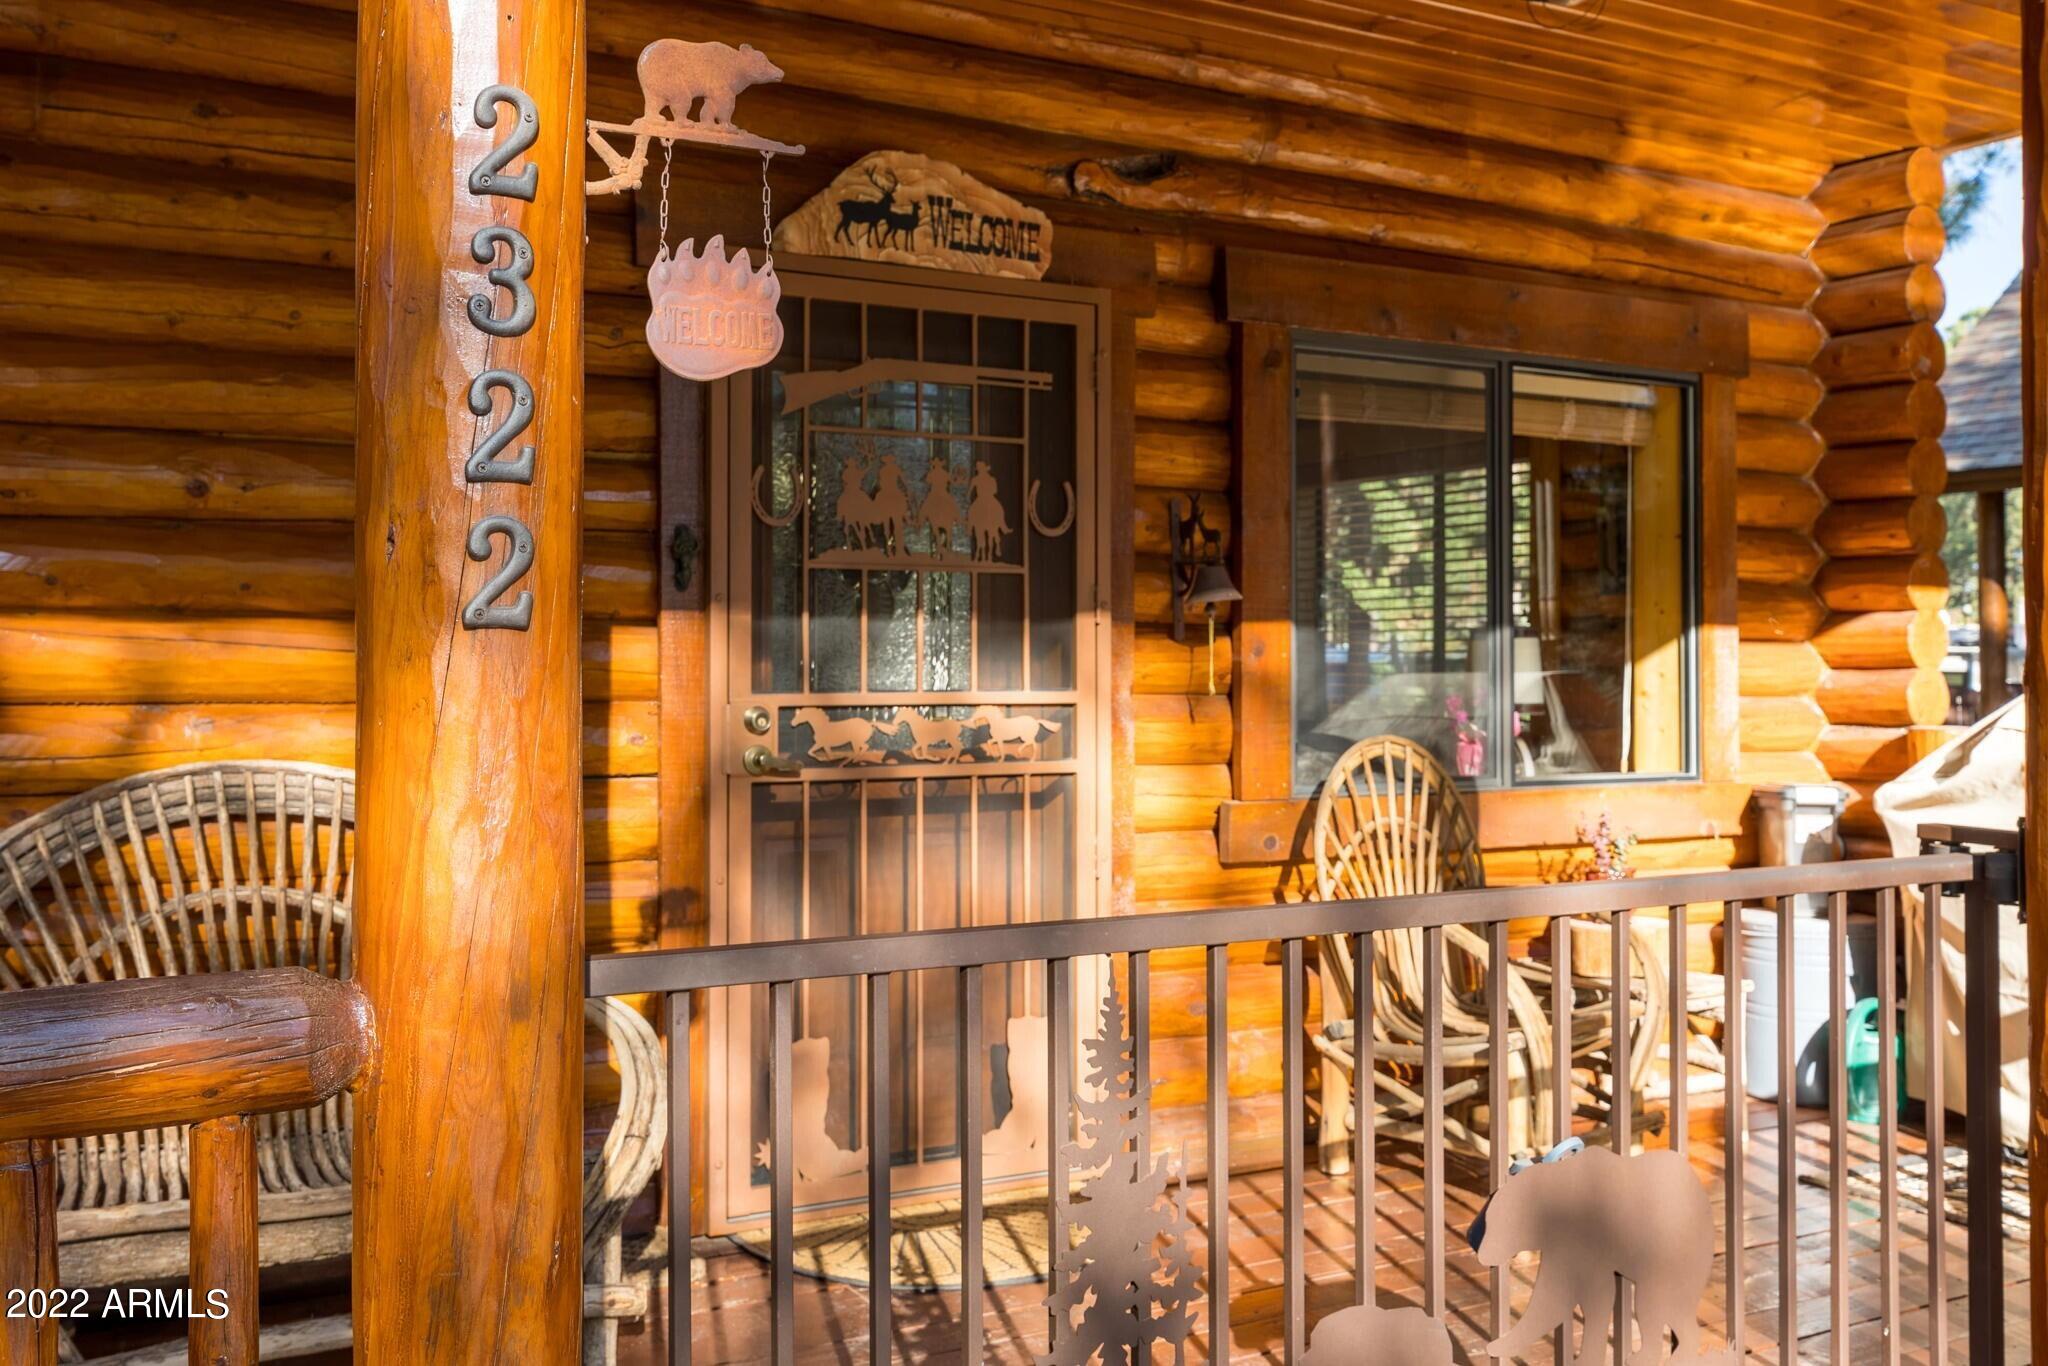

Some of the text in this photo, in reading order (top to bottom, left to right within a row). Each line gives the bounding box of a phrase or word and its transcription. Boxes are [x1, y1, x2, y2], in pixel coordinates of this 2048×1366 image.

[927, 194, 1041, 263] WELCOME
[462, 85, 539, 631] 2322
[660, 304, 775, 350] WELCOME
